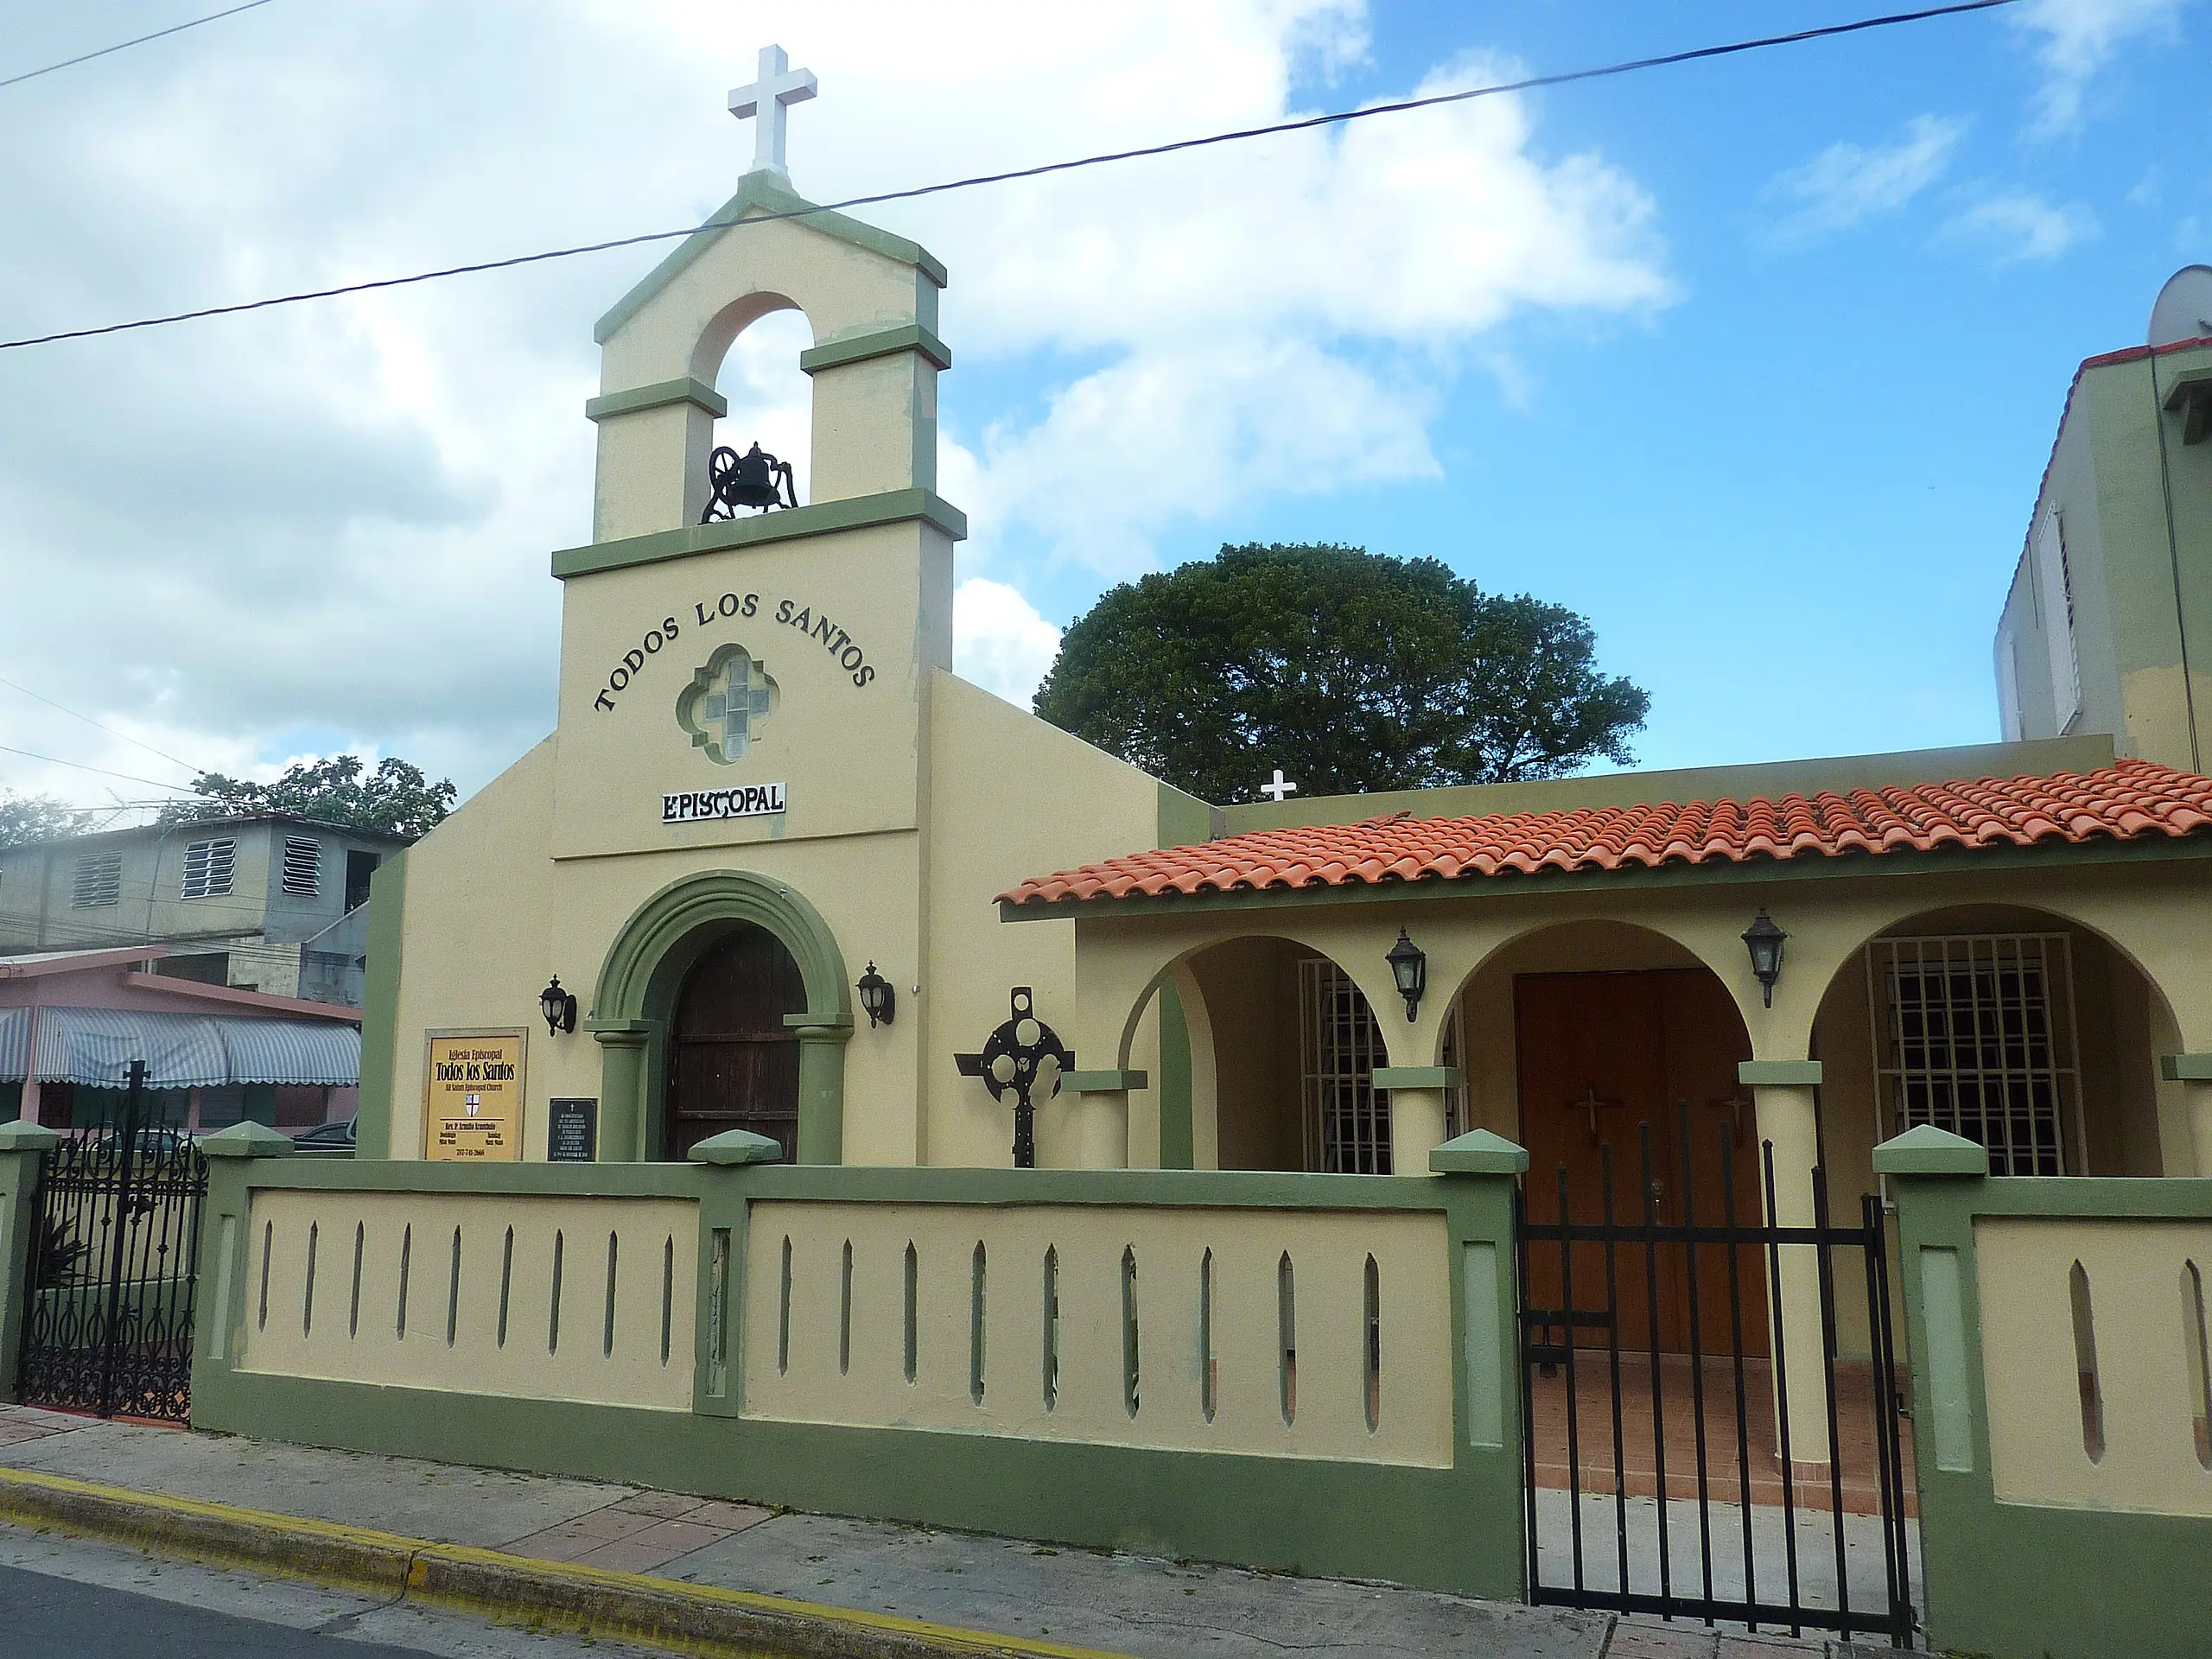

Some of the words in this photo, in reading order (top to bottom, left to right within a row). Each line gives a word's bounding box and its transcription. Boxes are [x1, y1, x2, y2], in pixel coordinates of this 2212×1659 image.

[594, 616, 679, 713] TODOS
[695, 592, 760, 627] LOS
[775, 599, 876, 689] SANTOS
[662, 785, 784, 819] EPISCOPAL
[448, 1050, 470, 1061] Iglesia
[472, 1049, 502, 1061] Episcopal
[435, 1062, 463, 1081] Todos
[466, 1062, 480, 1081] los
[482, 1061, 515, 1081] Santos
[465, 1084, 486, 1092] Episcopal
